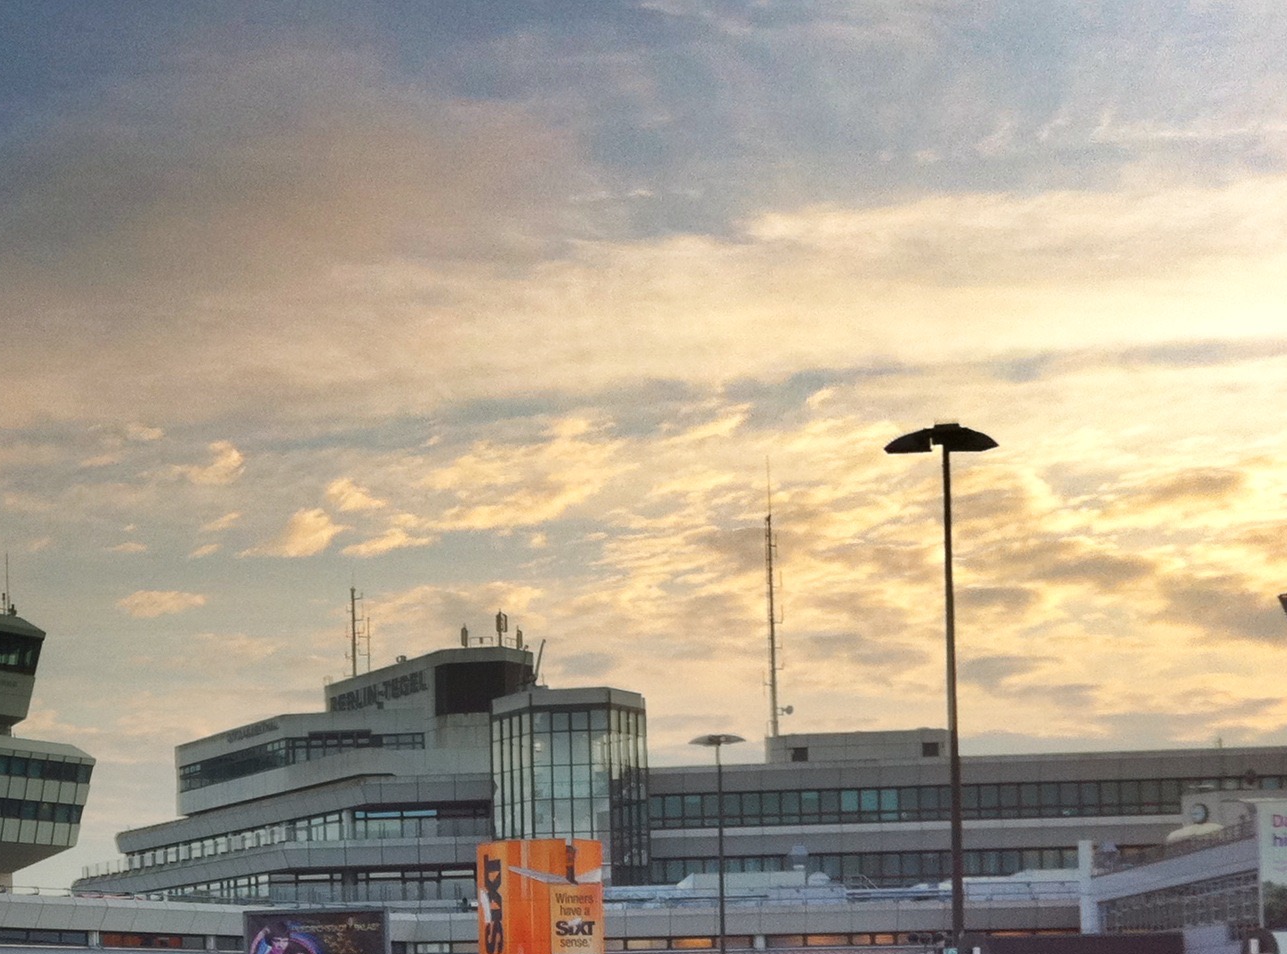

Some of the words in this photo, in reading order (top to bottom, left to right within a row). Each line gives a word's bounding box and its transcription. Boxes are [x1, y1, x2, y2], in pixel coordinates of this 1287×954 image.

[555, 892, 593, 905] Winners
[559, 904, 582, 916] have
[584, 907, 591, 916] a
